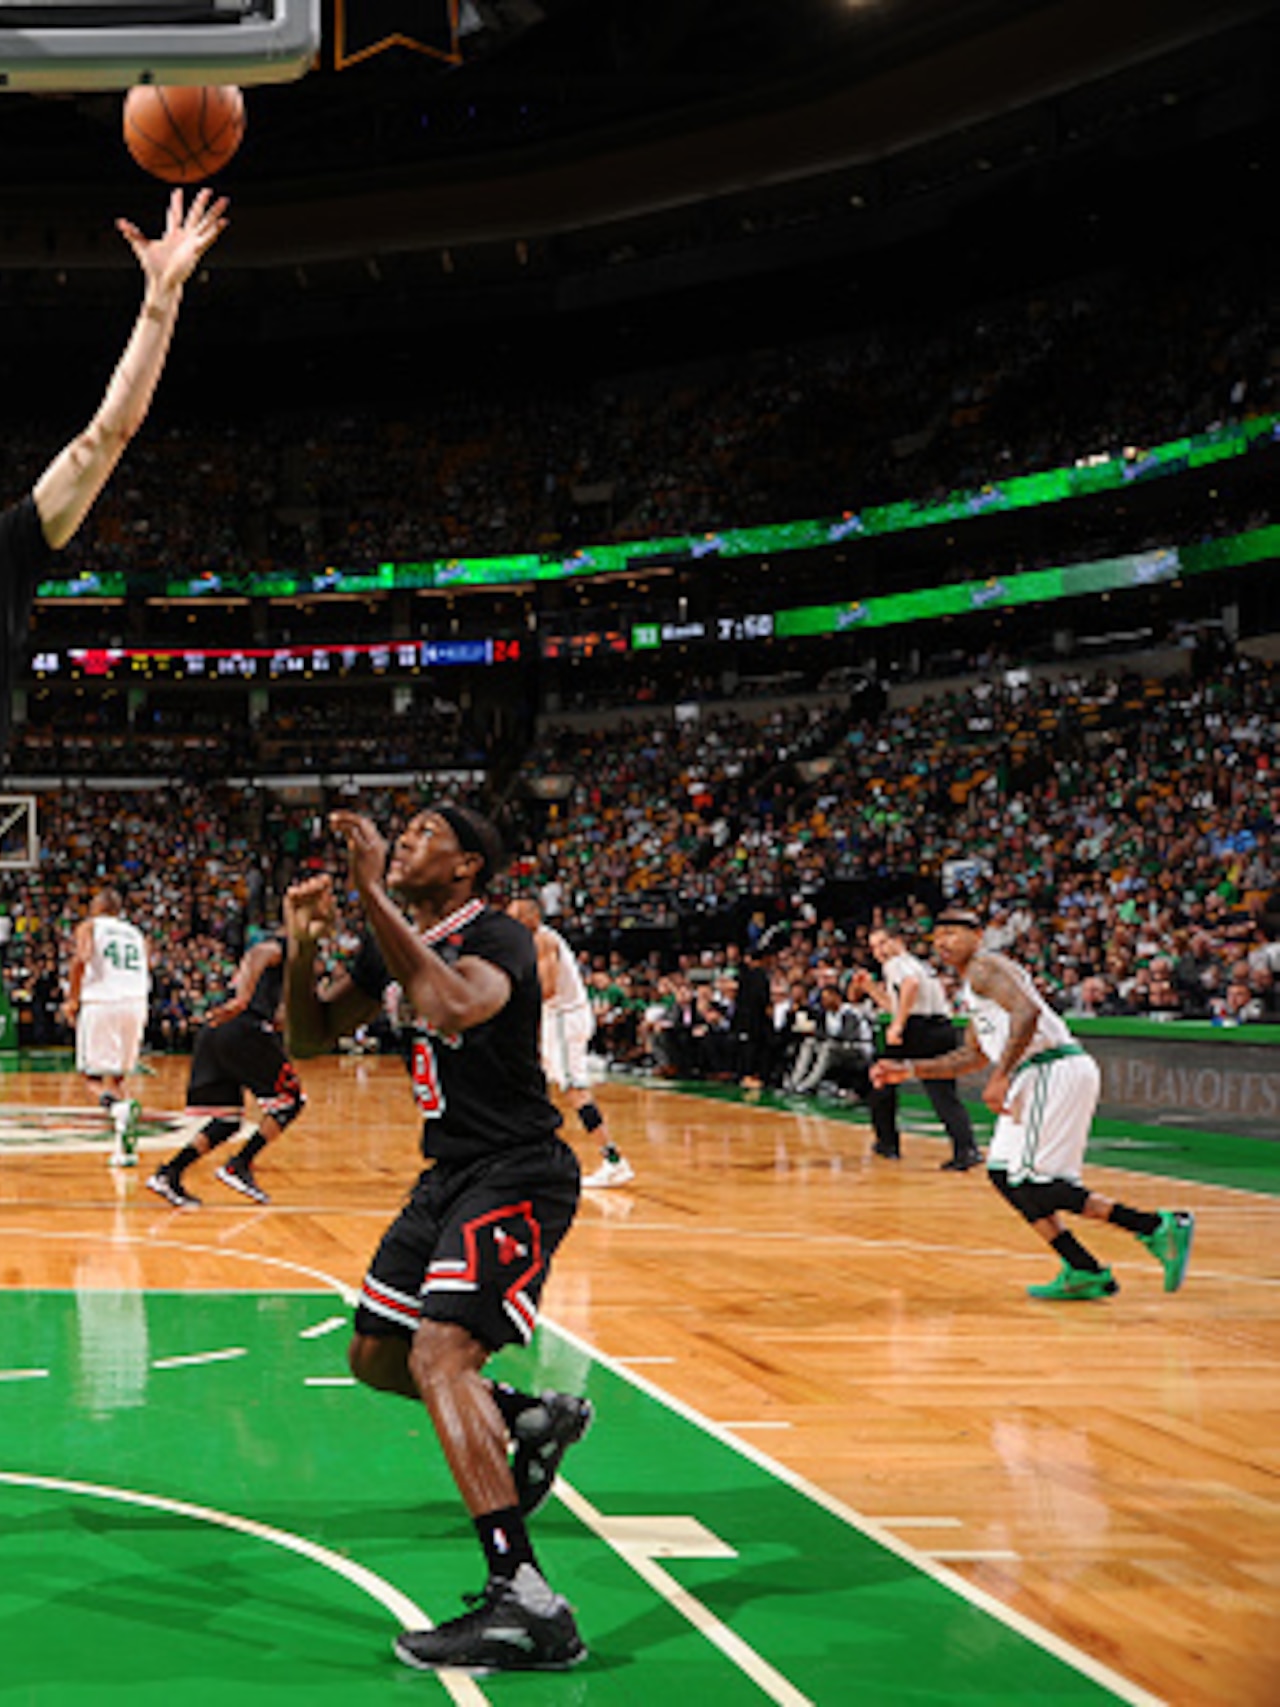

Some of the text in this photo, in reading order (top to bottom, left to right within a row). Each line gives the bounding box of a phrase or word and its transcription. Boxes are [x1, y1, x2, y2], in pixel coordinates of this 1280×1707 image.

[493, 640, 520, 663] 24
[103, 939, 141, 971] 42
[1122, 1058, 1280, 1119] PLAYOFFS
